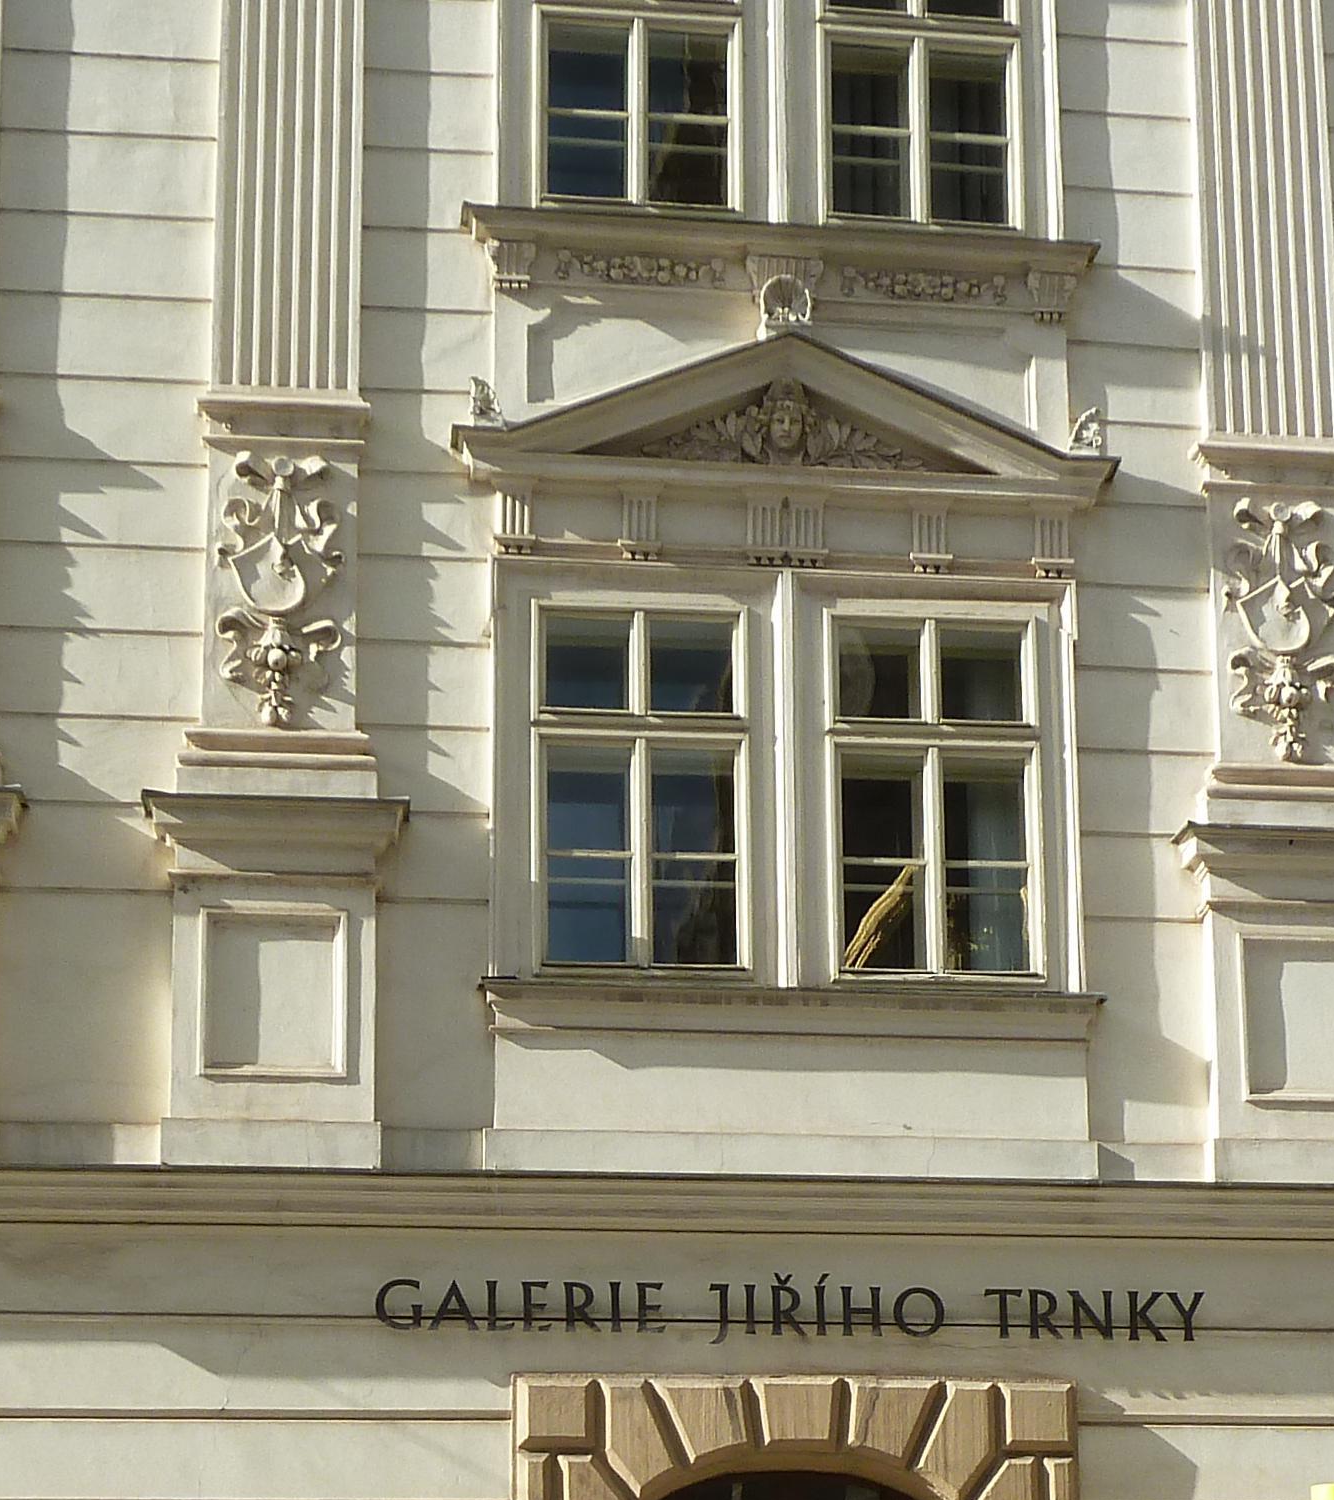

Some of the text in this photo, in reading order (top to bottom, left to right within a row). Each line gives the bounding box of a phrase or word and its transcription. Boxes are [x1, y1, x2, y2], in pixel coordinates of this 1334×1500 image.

[374, 1272, 1205, 1344] GALERIE JIŘÍHO TRNKY
